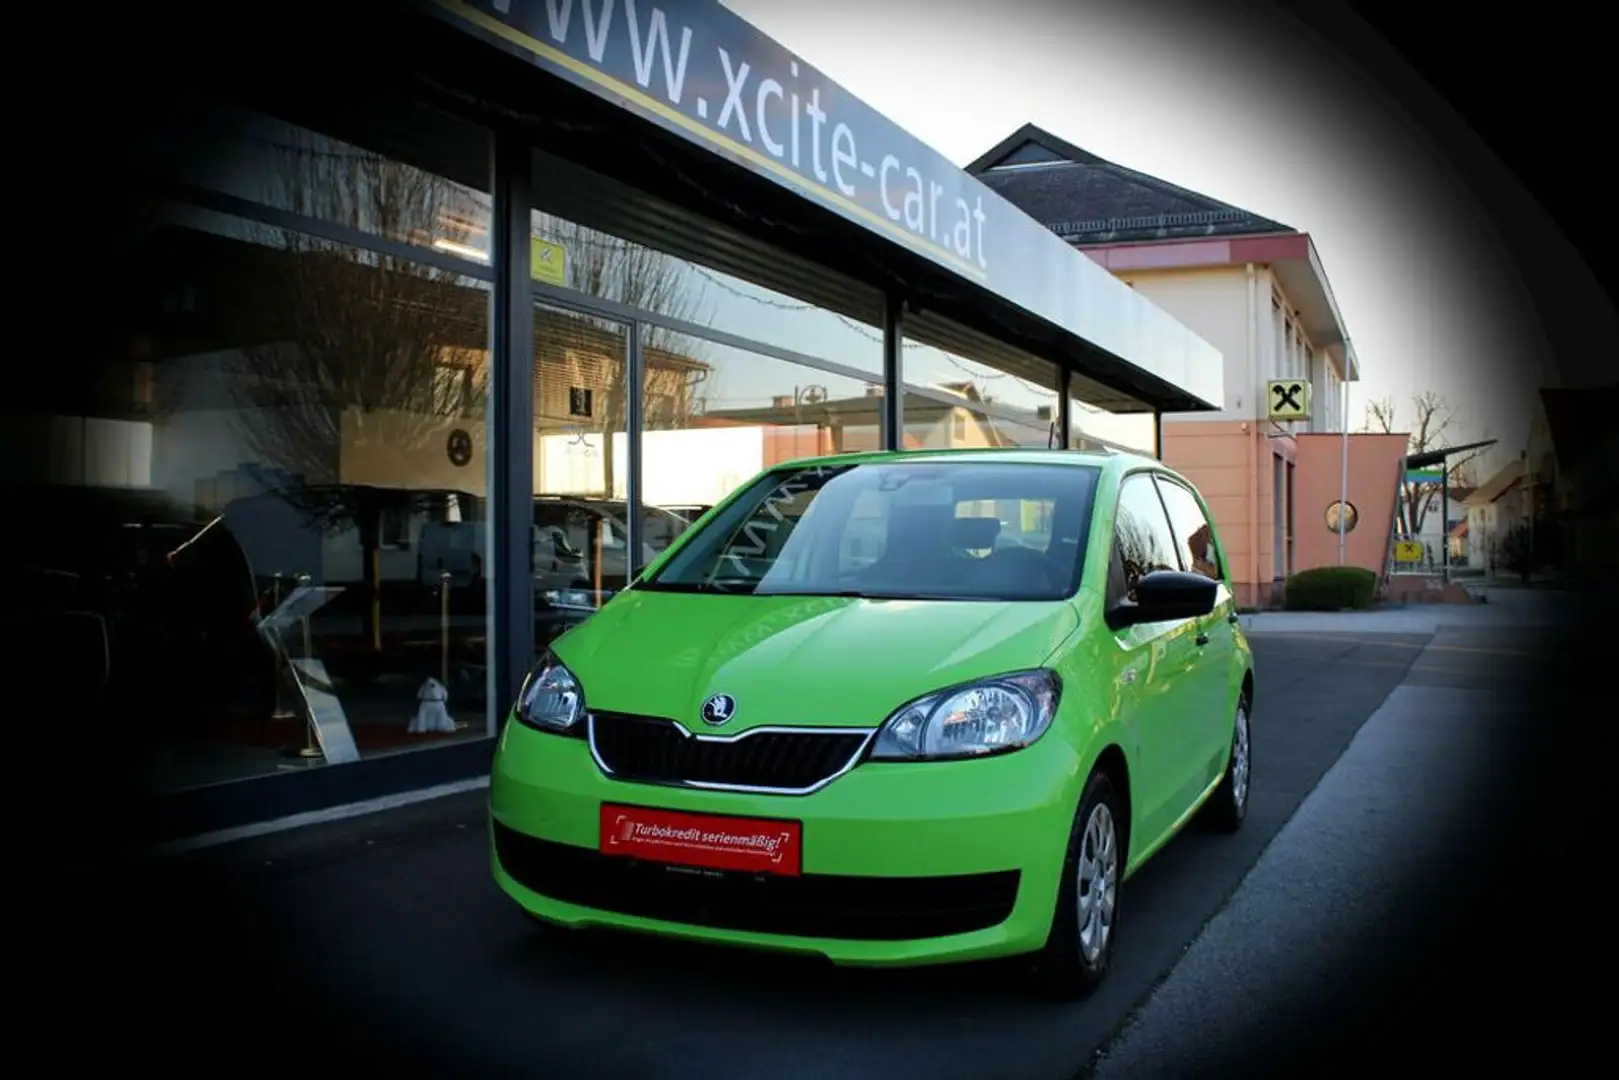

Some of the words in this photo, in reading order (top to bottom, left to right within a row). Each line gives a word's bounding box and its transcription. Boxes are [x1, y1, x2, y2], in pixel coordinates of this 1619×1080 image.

[494, 0, 987, 269] ww.xcite-car.at
[635, 822, 701, 841] Turbokredit
[701, 831, 782, 851] serienmäßig!
